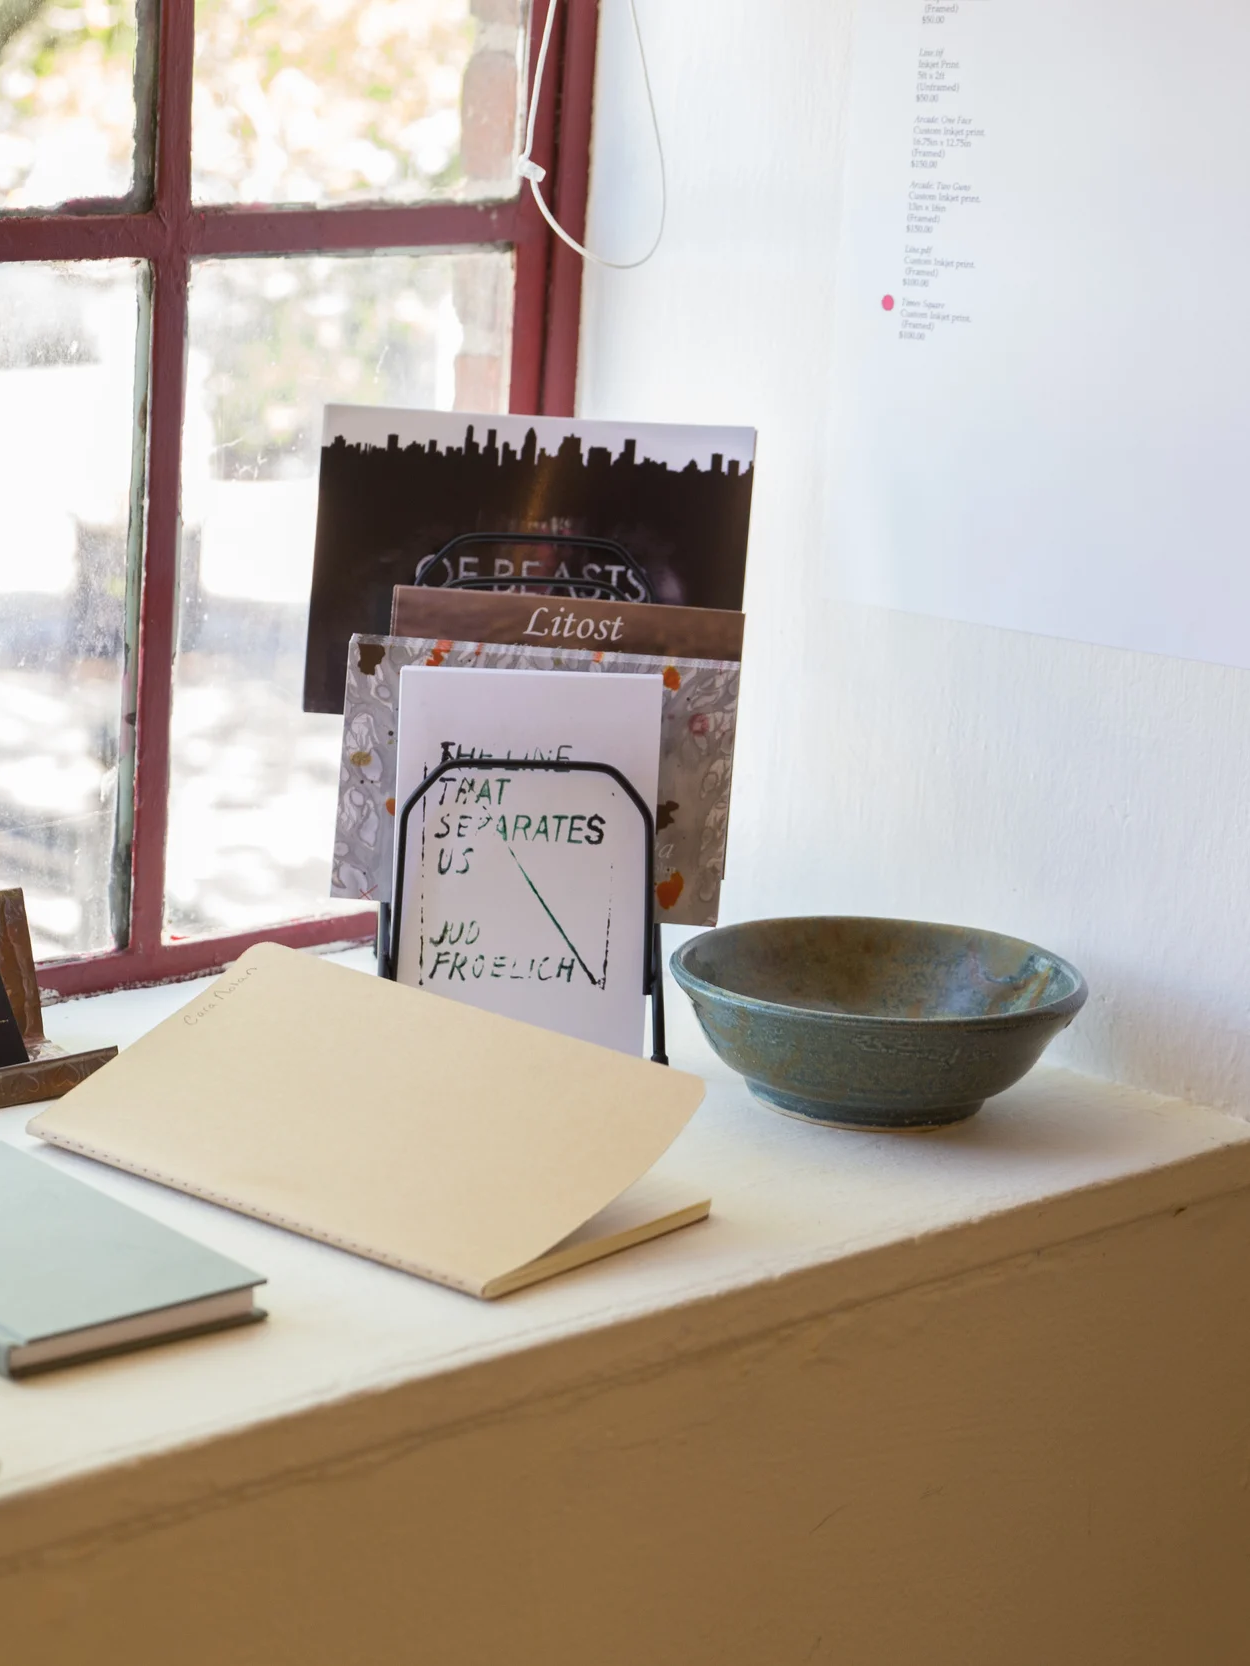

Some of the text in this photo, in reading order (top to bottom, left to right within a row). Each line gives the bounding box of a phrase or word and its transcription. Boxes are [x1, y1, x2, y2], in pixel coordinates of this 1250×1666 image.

[493, 558, 647, 604] BEASTS
[523, 607, 625, 642] Litost
[439, 741, 494, 772] THE
[438, 776, 512, 806] THAT
[434, 808, 607, 846] SEPARATES
[437, 847, 474, 876] US
[428, 951, 576, 984] FROELICH
[183, 1002, 218, 1026] Cara
